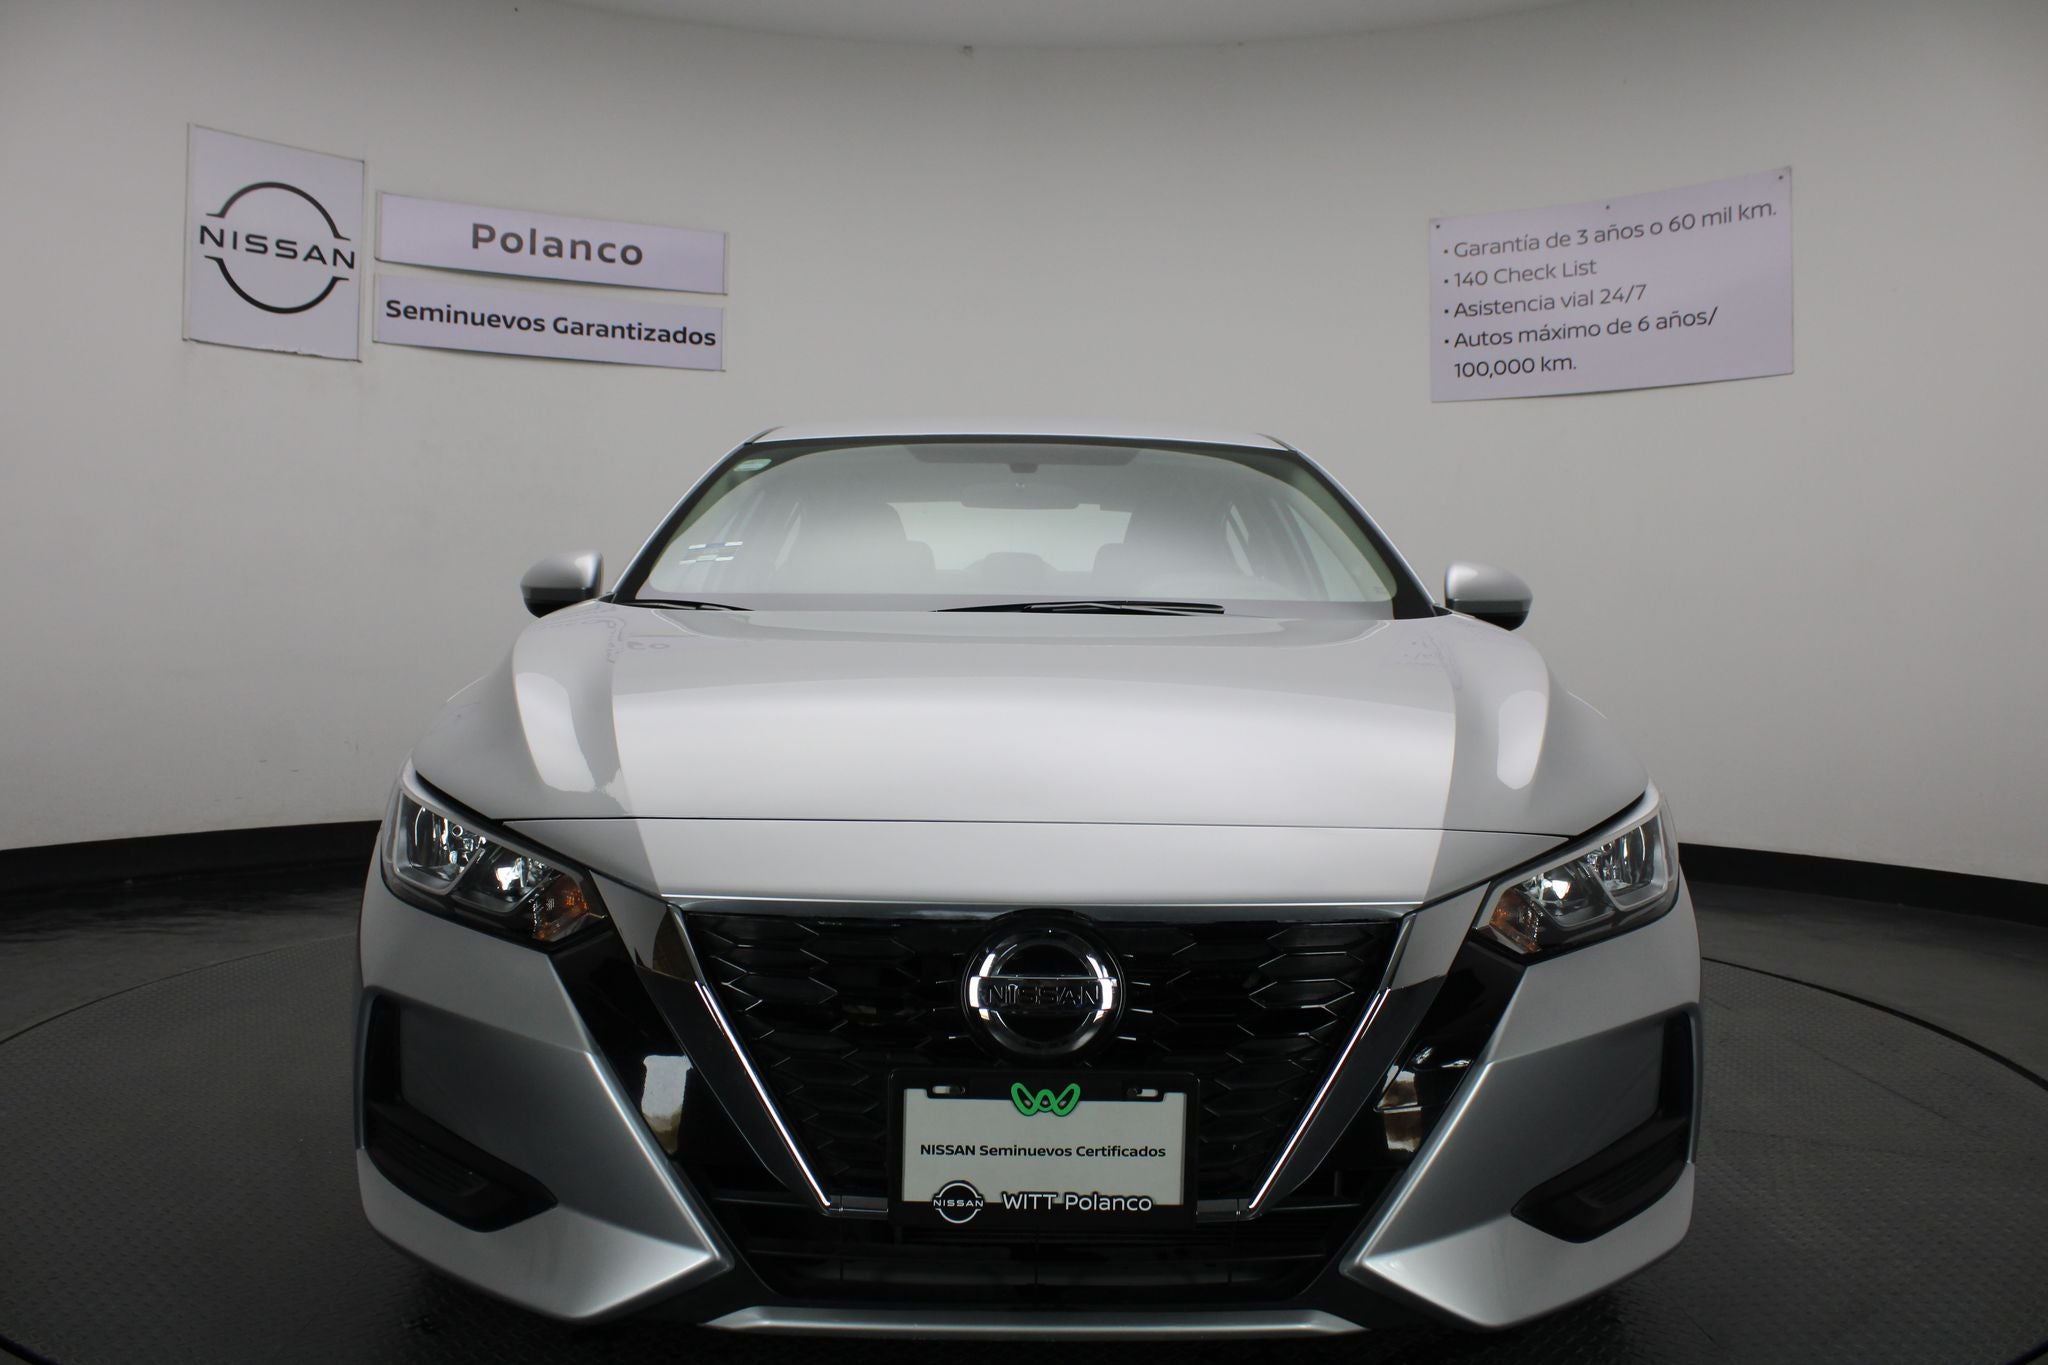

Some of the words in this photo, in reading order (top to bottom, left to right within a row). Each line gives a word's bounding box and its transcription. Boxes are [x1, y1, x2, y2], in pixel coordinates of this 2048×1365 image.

[471, 223, 643, 265] Polanco
[1454, 234, 1540, 258] Garantía
[1545, 231, 1571, 249] de
[1576, 229, 1589, 245] 3
[1594, 223, 1645, 243] años
[1649, 221, 1663, 235] o
[1668, 213, 1696, 232] 60
[1701, 206, 1732, 228] mil
[1738, 201, 1777, 221] km.
[199, 225, 355, 269] NISSAN
[1454, 270, 1488, 287] 140
[1494, 263, 1556, 285] Check
[1562, 259, 1597, 278] List
[1453, 297, 1555, 318] Asistencia
[1560, 289, 1594, 309] vial
[1600, 284, 1647, 305] 24/7
[385, 299, 546, 332] Seminuevos
[553, 316, 716, 346] Garantizados
[1454, 329, 1513, 348] Autos
[1518, 322, 1601, 344] máximo
[1606, 317, 1633, 336] de
[1638, 315, 1650, 332] 6
[1656, 306, 1719, 330] años/
[1454, 357, 1535, 380] 100,000
[1540, 353, 1577, 373] km.
[920, 1144, 976, 1156] NISSAN
[979, 1144, 1072, 1157] Seminuevos
[1076, 1145, 1166, 1158] Certificados
[933, 1199, 984, 1208] NISSAN
[1002, 1193, 1058, 1210] WITT
[1065, 1193, 1153, 1211] Polanco
